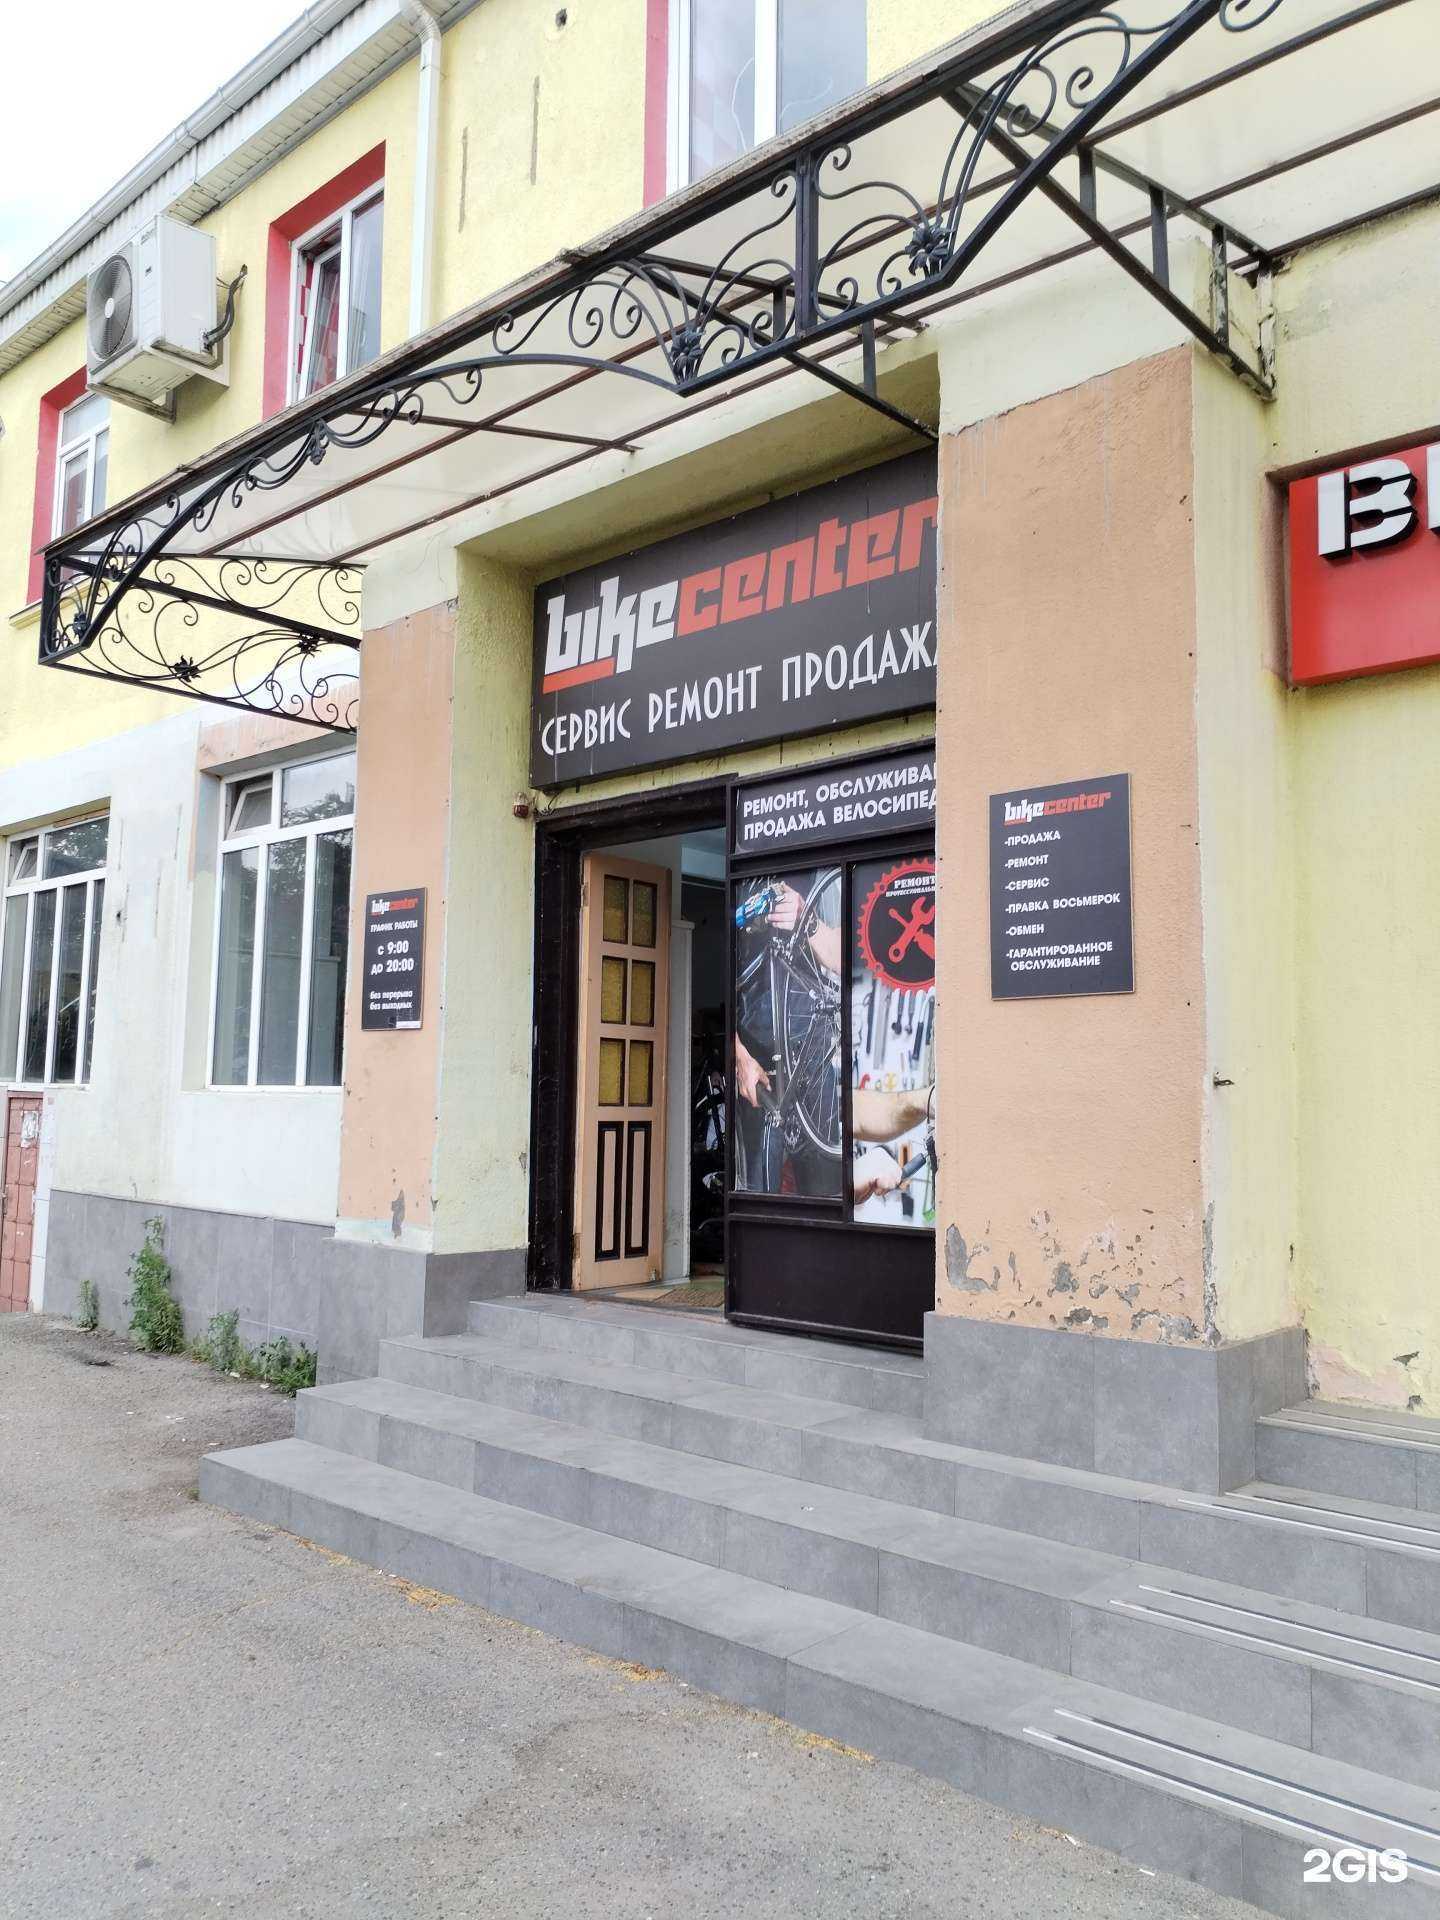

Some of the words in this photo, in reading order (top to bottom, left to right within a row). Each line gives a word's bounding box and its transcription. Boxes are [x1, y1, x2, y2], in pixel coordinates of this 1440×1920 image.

[1317, 441, 1440, 557] В
[541, 698, 631, 756] СЕРВИС
[648, 665, 762, 733] РЕМОНТ
[782, 620, 938, 702] ПРОДАЖ
[743, 789, 809, 817] РЕМОНТ,
[816, 762, 936, 803] ОБСЛУЖИВА
[1004, 792, 1111, 822] bikecenter
[744, 810, 827, 840] ПРОДАЖА
[894, 875, 935, 889] РЕМОНТ
[1053, 893, 1120, 909] ВОСЬМЕРОК
[370, 922, 394, 932] ГРАФИК
[394, 919, 418, 930] РАБОТЫ
[387, 940, 409, 954] 9:00
[386, 958, 415, 973] 20:00
[1011, 955, 1101, 971] ОБСЛУЖИВАНИЕ
